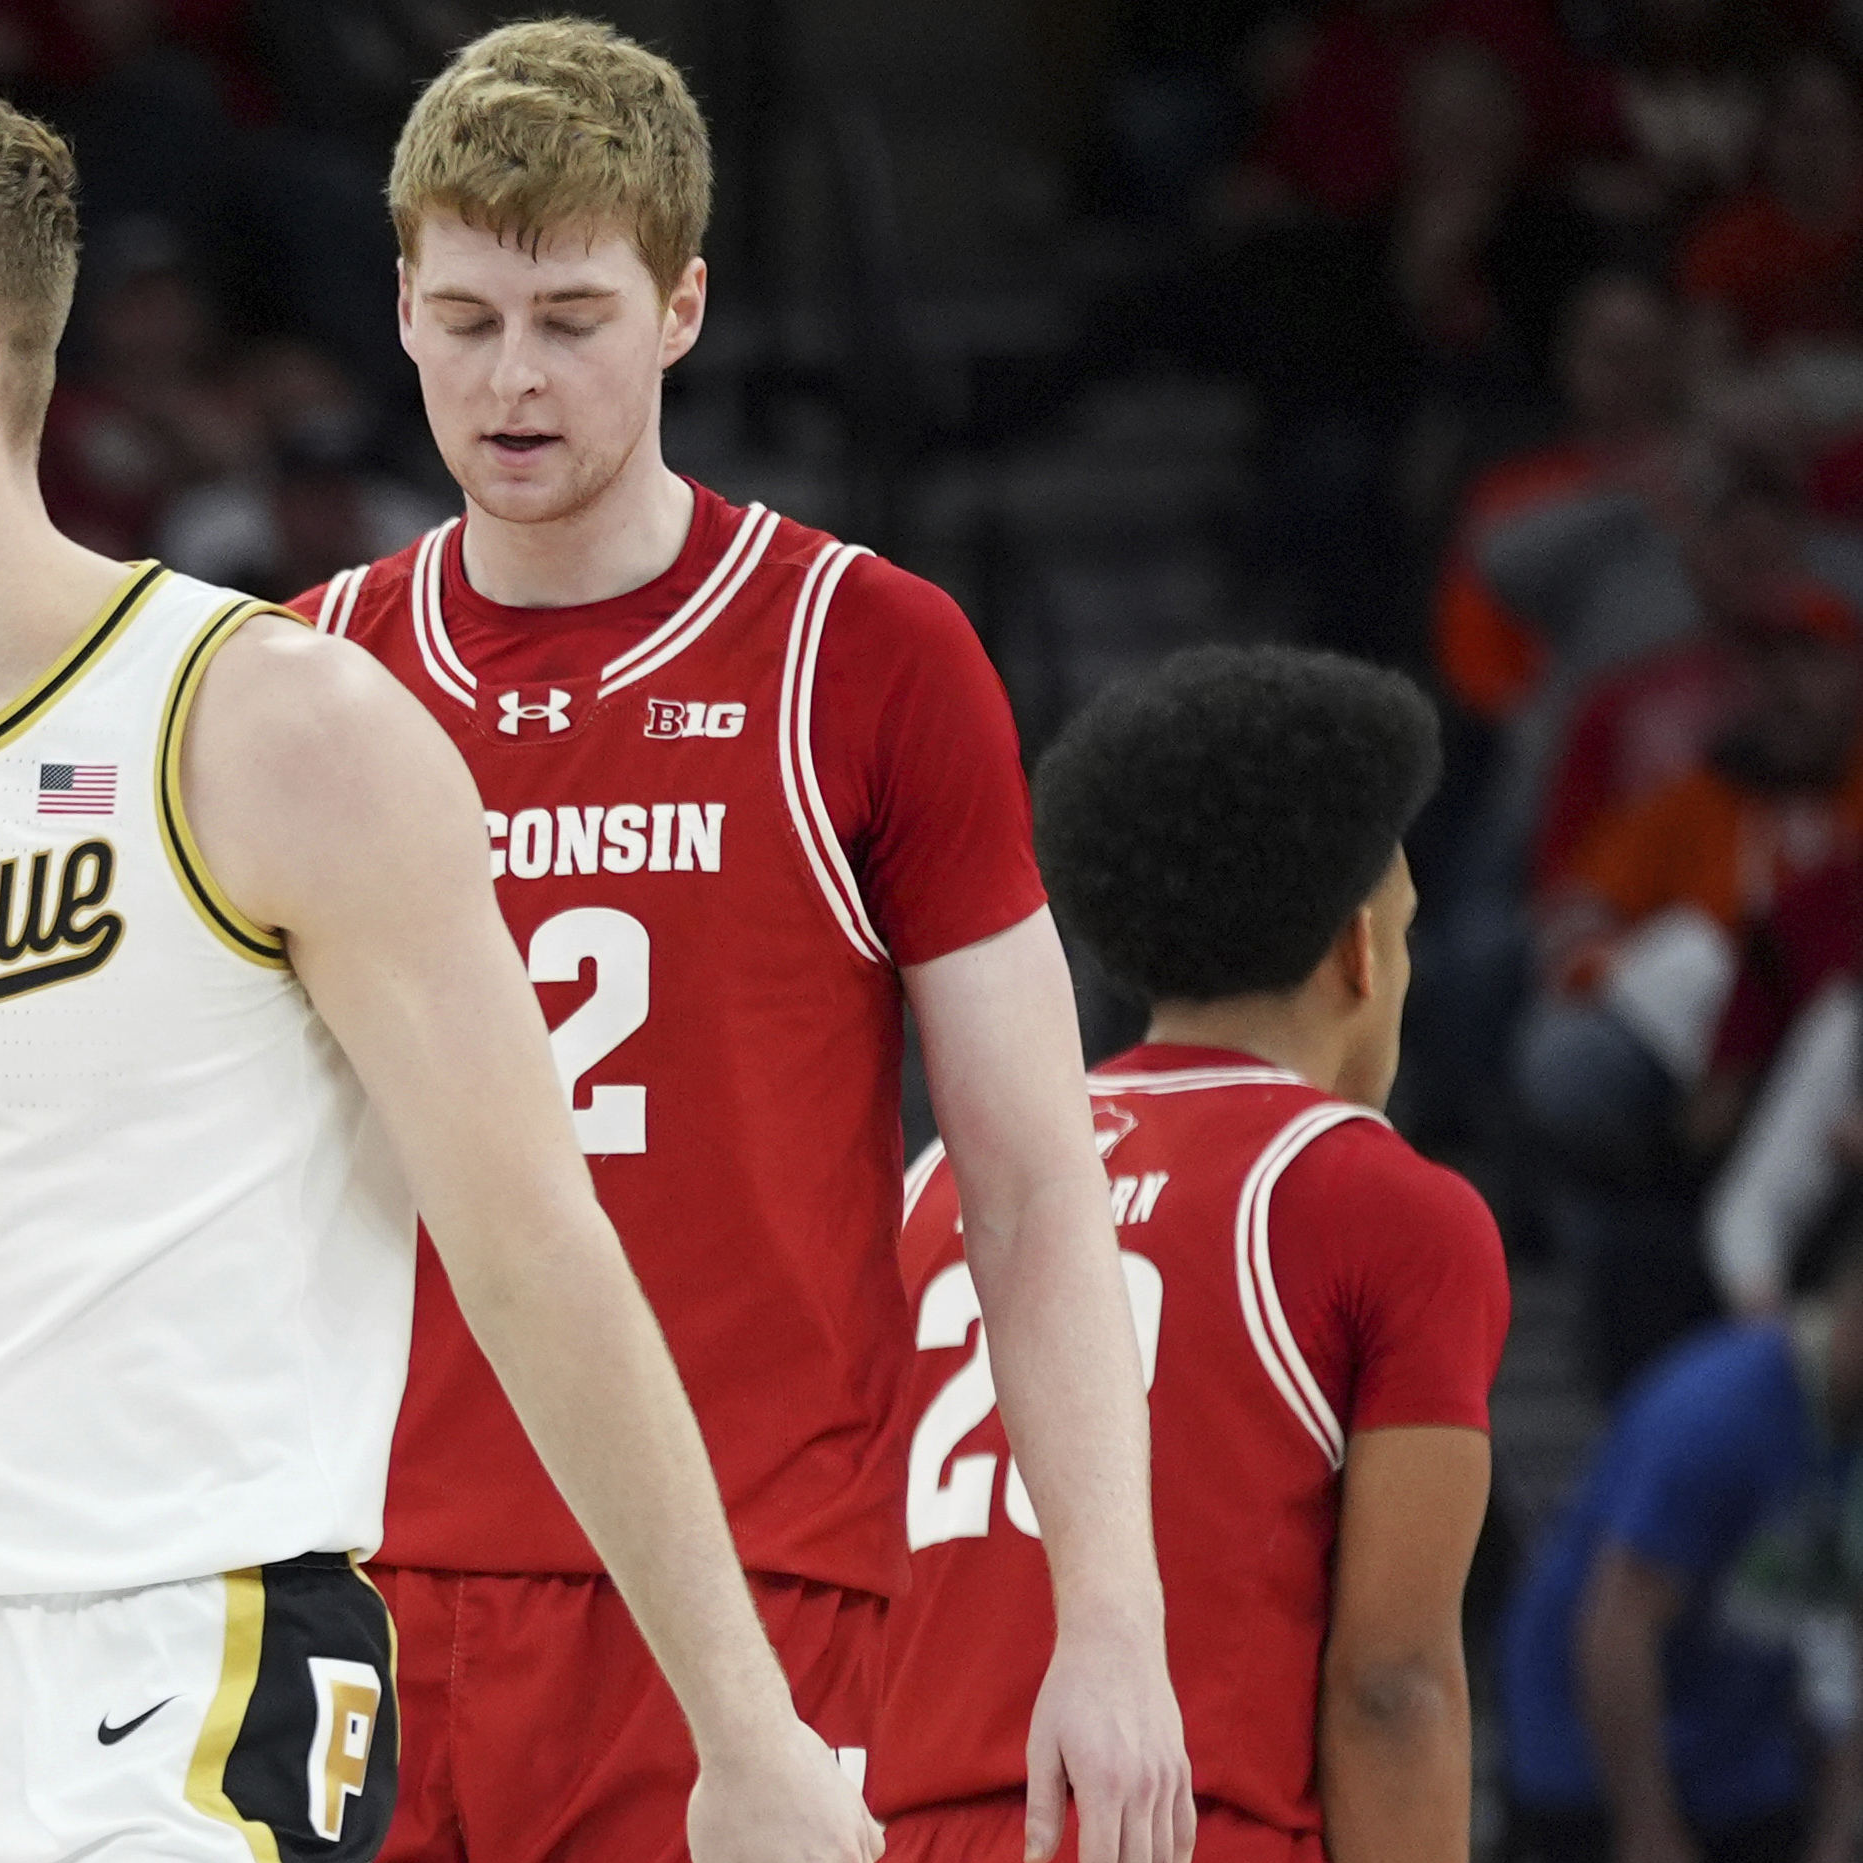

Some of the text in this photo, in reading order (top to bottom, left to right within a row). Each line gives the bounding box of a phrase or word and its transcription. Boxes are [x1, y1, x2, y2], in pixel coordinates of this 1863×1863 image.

[483, 802, 726, 880] CONSIN
[528, 906, 651, 1155] 2
[306, 1656, 382, 1843] P
